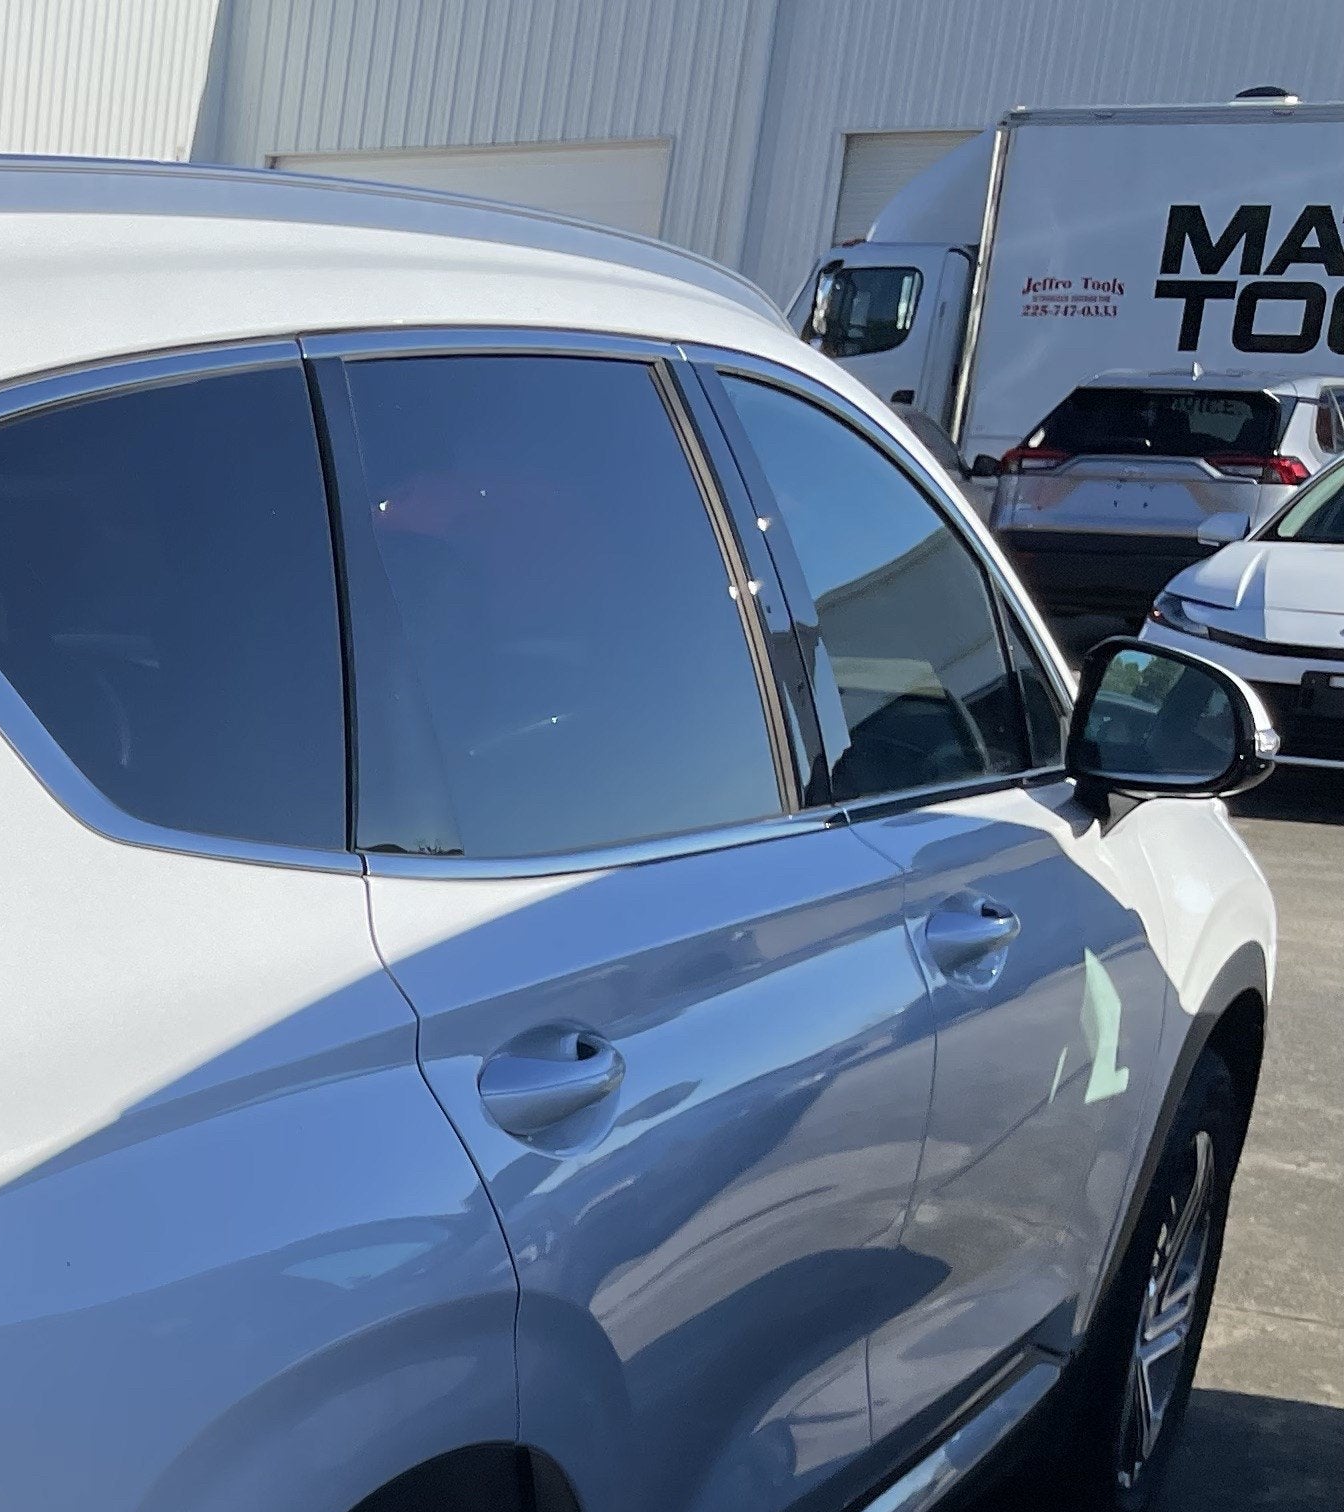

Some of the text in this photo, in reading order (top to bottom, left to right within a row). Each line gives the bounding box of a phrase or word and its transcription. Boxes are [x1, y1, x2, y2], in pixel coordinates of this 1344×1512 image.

[1160, 205, 1344, 276] MA
[1081, 277, 1125, 296] Tools
[1155, 280, 1344, 355] TO
